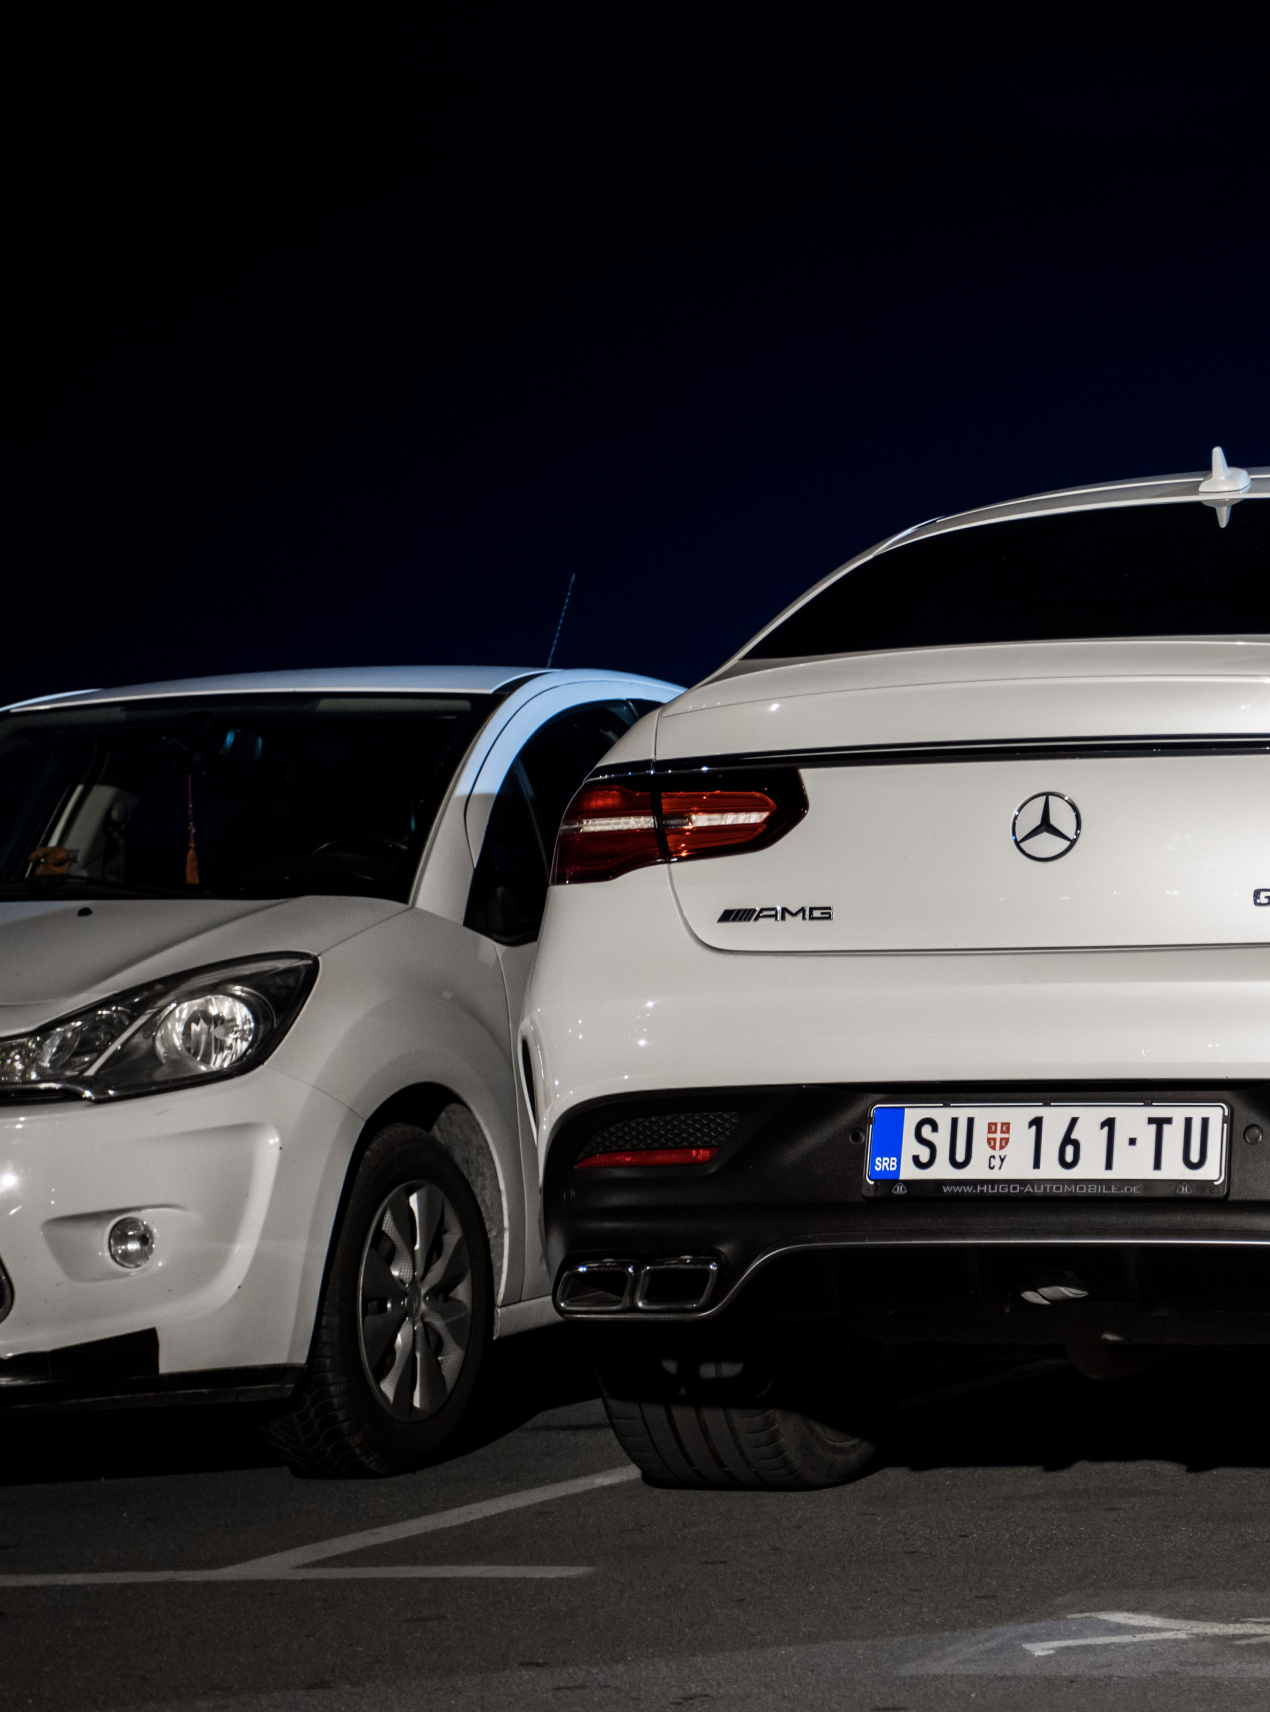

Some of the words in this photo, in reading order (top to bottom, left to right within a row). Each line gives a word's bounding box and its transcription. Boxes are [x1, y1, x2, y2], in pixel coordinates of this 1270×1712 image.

[753, 905, 835, 922] AMG
[911, 1116, 976, 1171] SU
[874, 1156, 898, 1172] SRB
